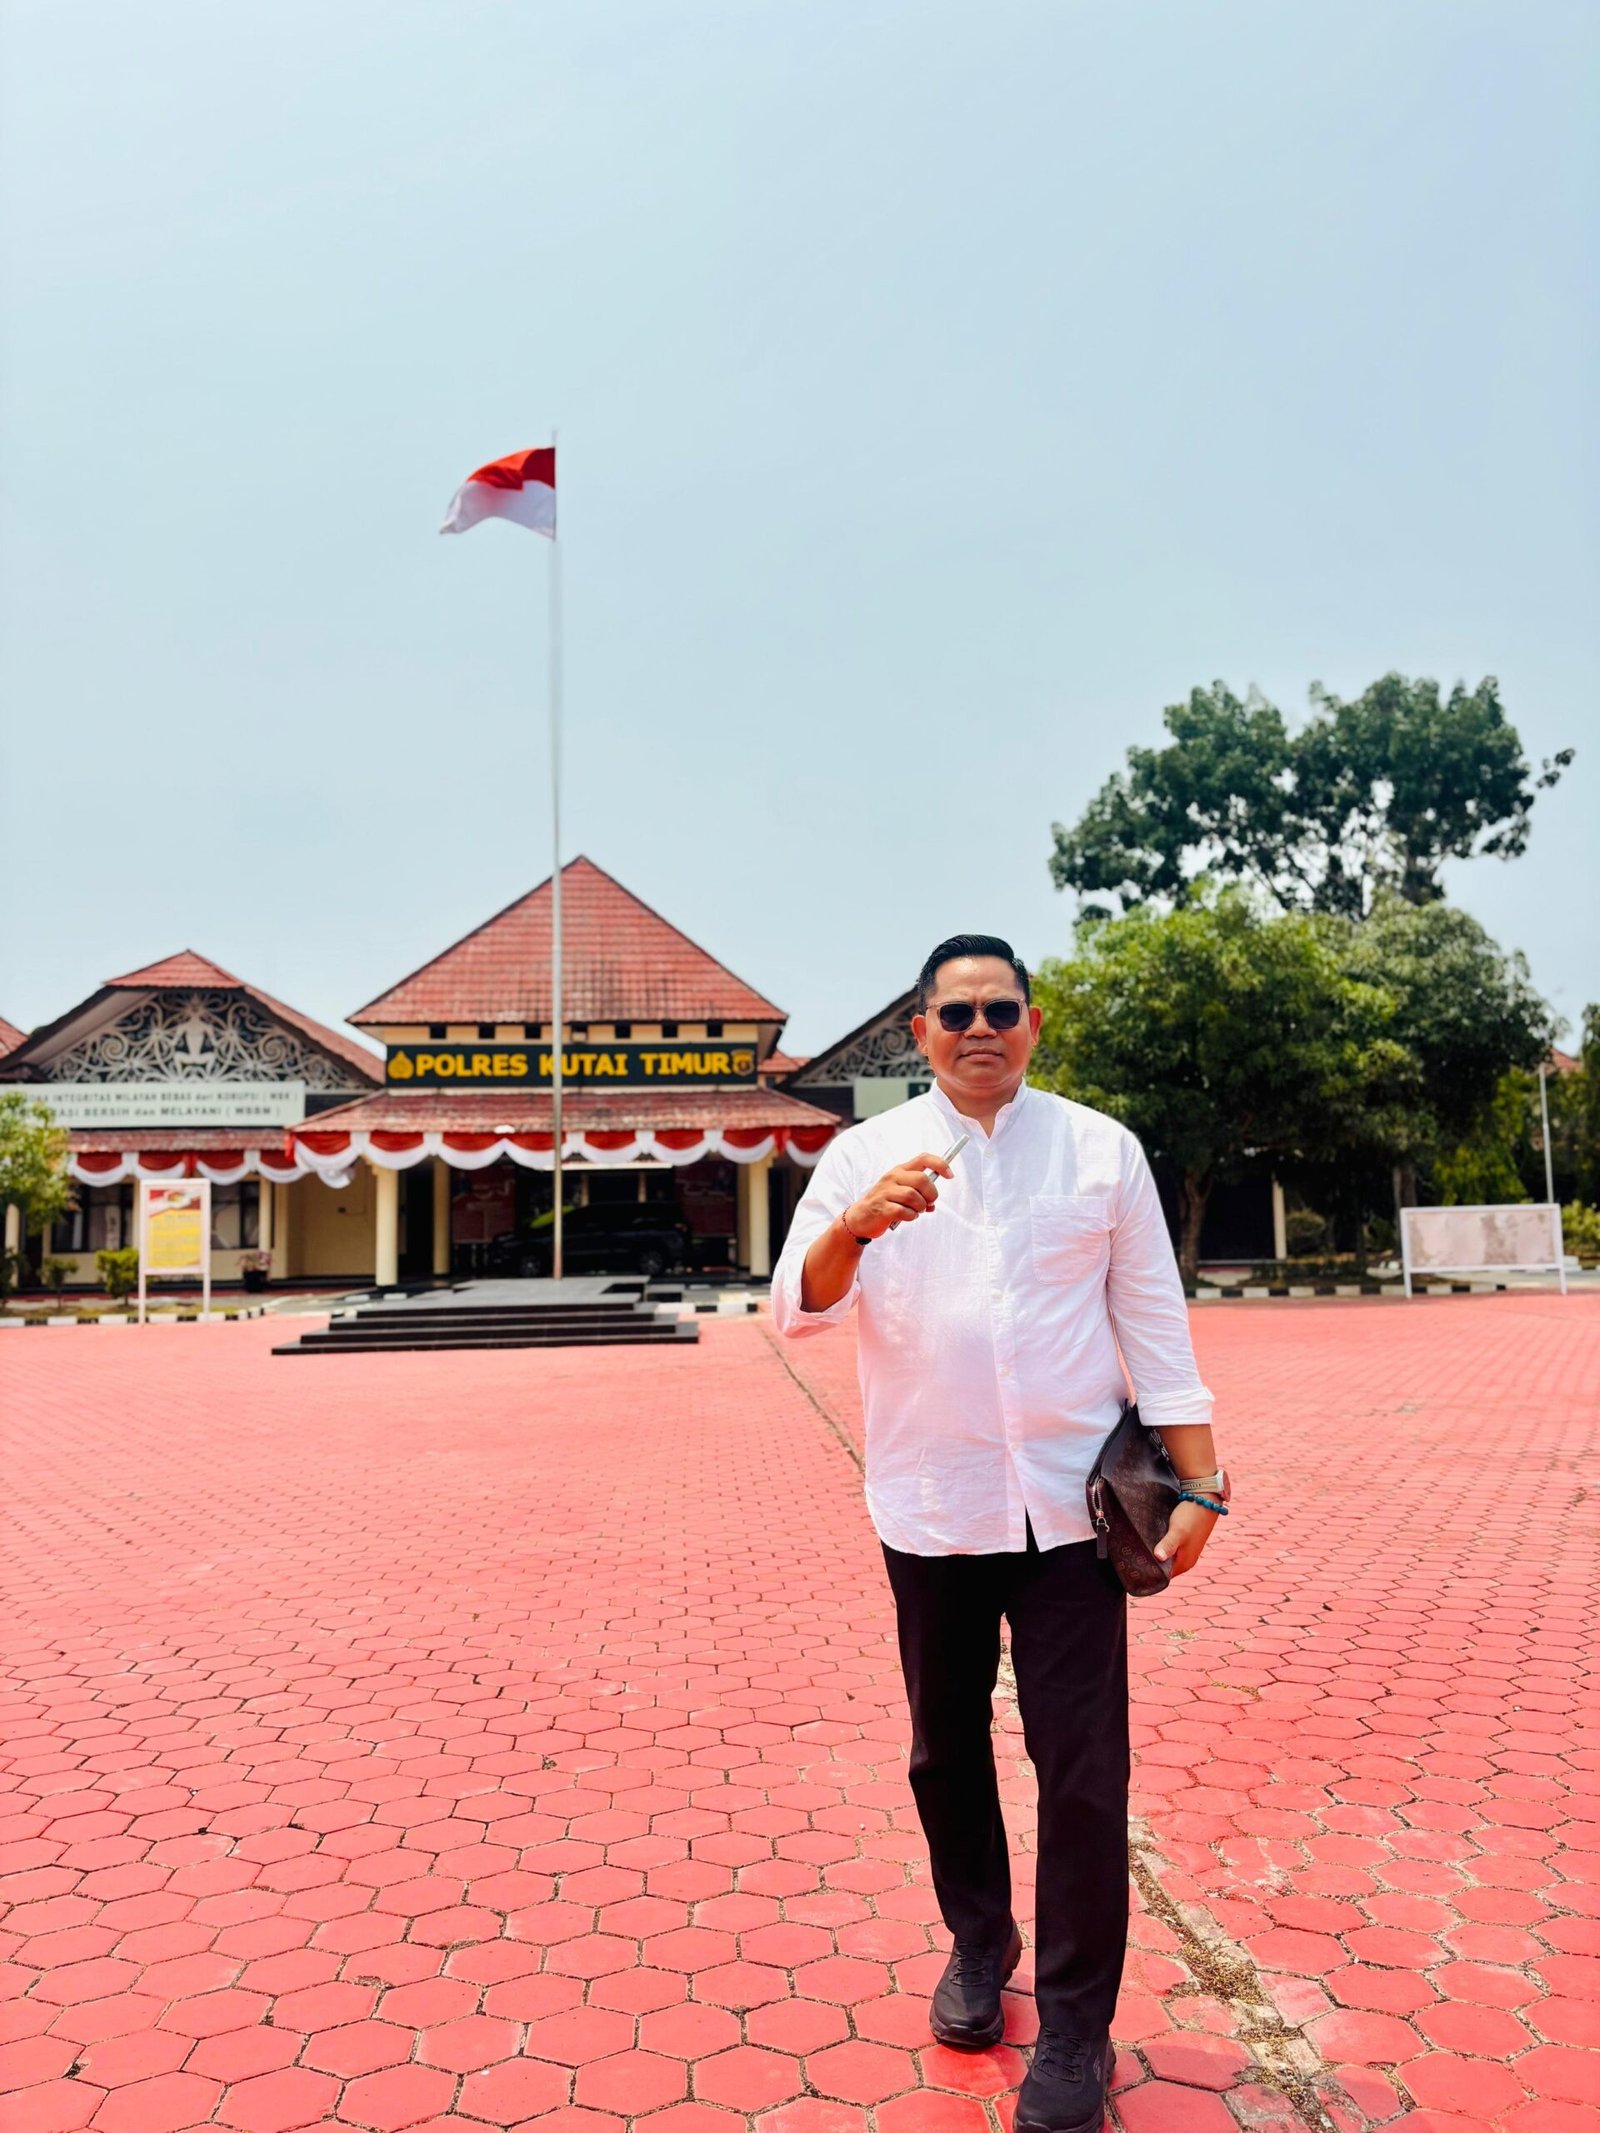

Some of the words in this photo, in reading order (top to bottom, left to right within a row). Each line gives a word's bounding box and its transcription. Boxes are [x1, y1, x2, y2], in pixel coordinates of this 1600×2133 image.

[415, 1053, 528, 1077] POLRES
[539, 1053, 628, 1077] KUTAI
[639, 1052, 731, 1076] TIMUR
[53, 1092, 111, 1102] INTEGRITAS
[84, 1107, 129, 1117] BERSIH
[134, 1107, 156, 1116] dan
[161, 1107, 221, 1116] MELAYANI
